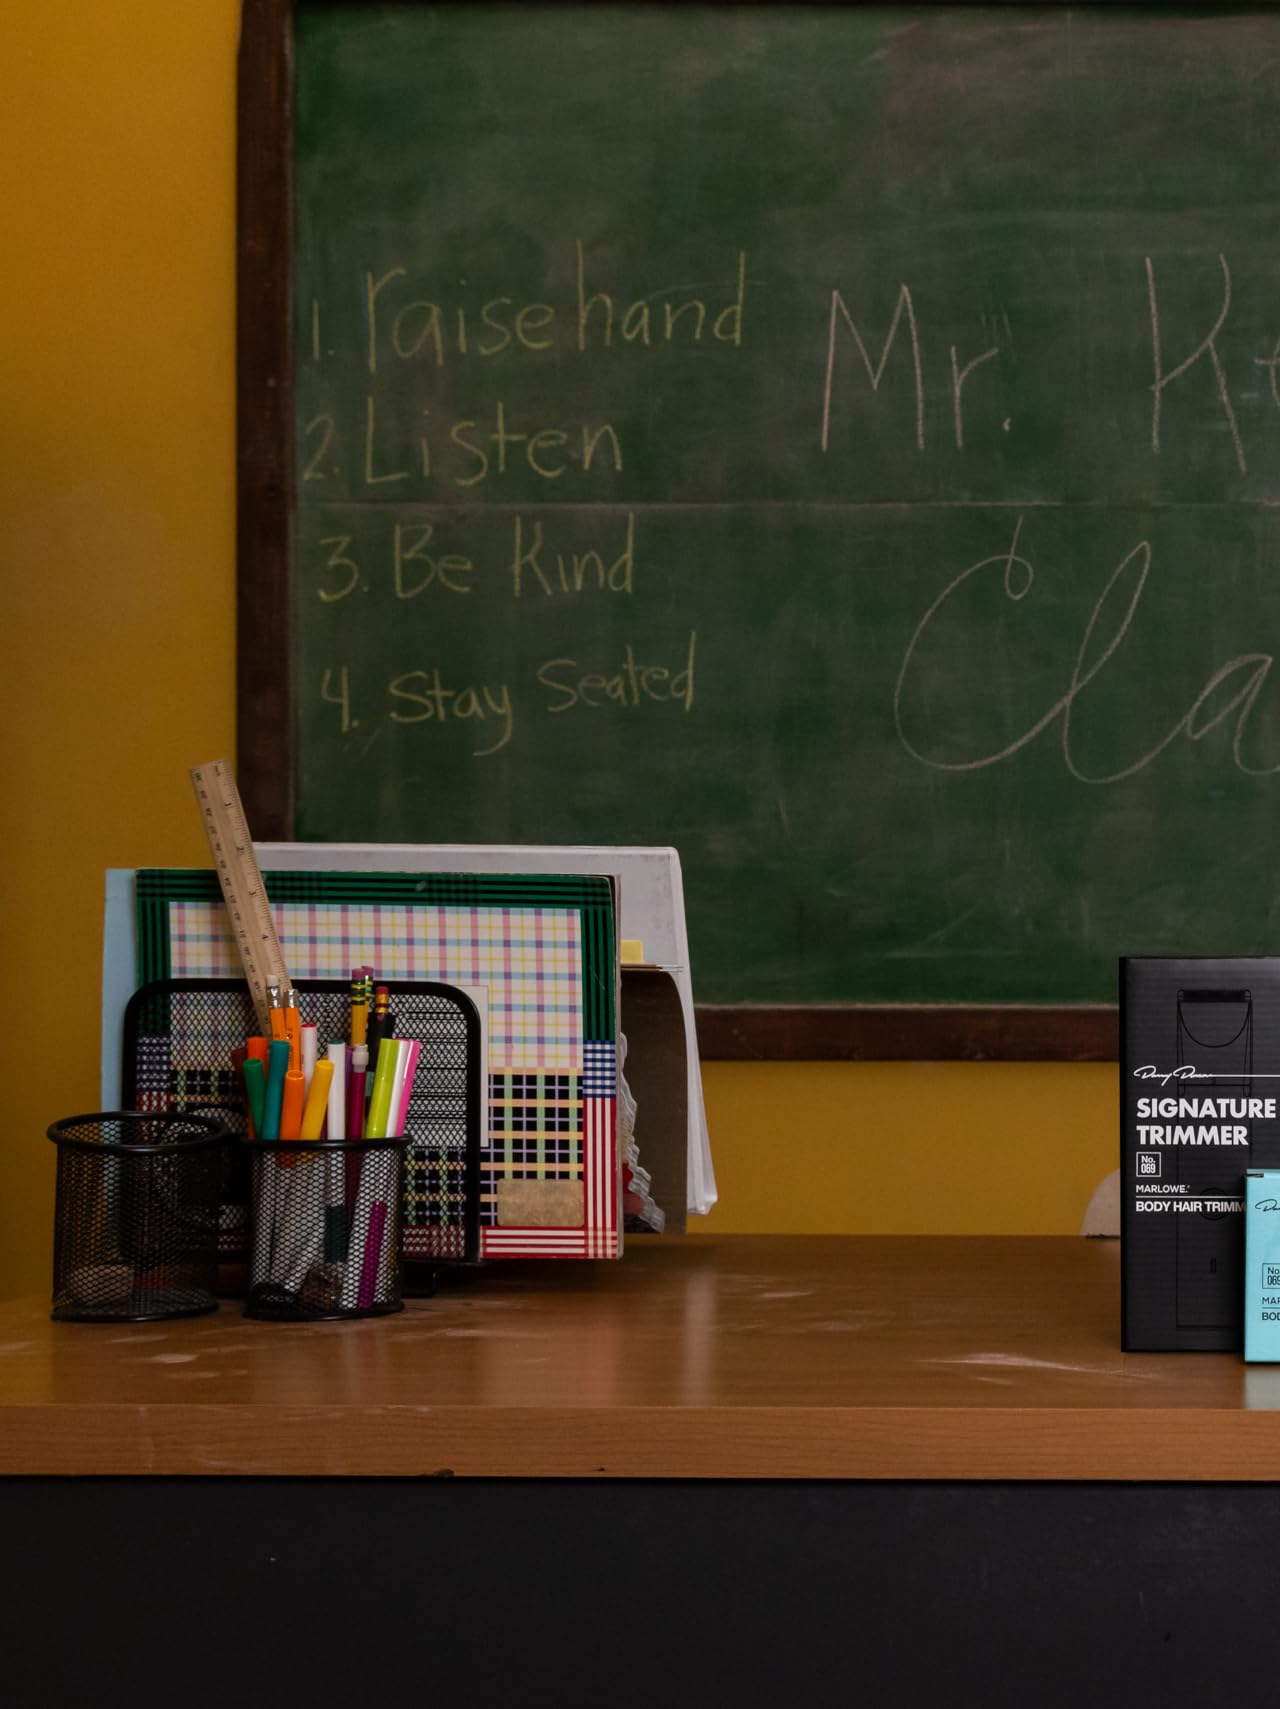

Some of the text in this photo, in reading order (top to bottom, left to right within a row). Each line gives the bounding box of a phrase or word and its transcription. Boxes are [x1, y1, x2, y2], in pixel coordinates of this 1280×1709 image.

[313, 299, 335, 361] 1.
[822, 283, 1012, 452] Mr.
[302, 396, 623, 486] 2. Listen
[317, 512, 635, 602] 3. Be Kind
[320, 630, 697, 756] 4. Stay Seated
[1136, 1098, 1277, 1119] SIGNATURE
[1136, 1125, 1249, 1146] TRIMMER
[1141, 1155, 1156, 1164] No.
[1141, 1164, 1156, 1174] 069
[1136, 1201, 1170, 1212] BODY
[1173, 1201, 1203, 1212] HAIR
